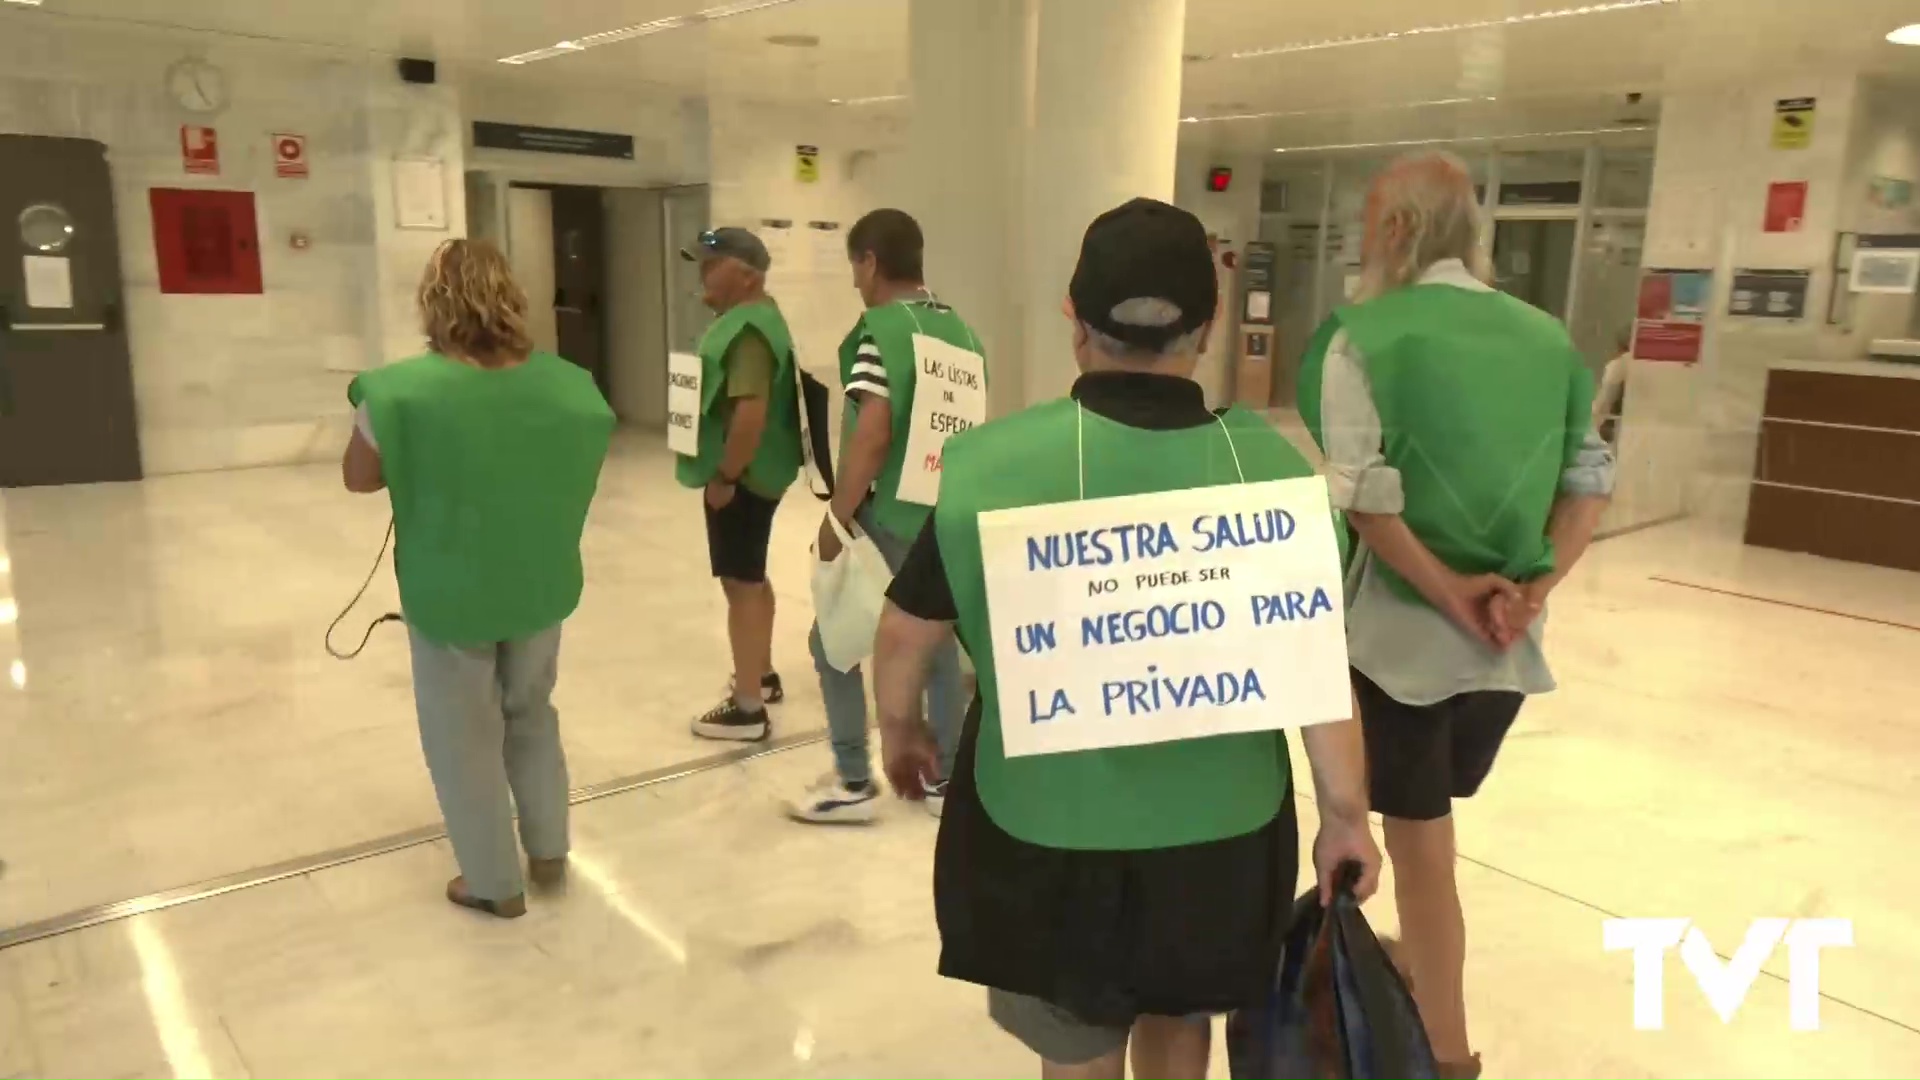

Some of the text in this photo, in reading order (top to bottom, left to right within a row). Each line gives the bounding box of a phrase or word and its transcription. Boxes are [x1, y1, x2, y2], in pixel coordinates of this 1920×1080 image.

[924, 357, 944, 379] LAS
[1027, 508, 1296, 571] NUESTRA SALUD
[1088, 566, 1230, 597] NO PUEDE SER
[1015, 586, 1333, 655] UN NEGOCIO PARA
[1029, 688, 1075, 724] LA
